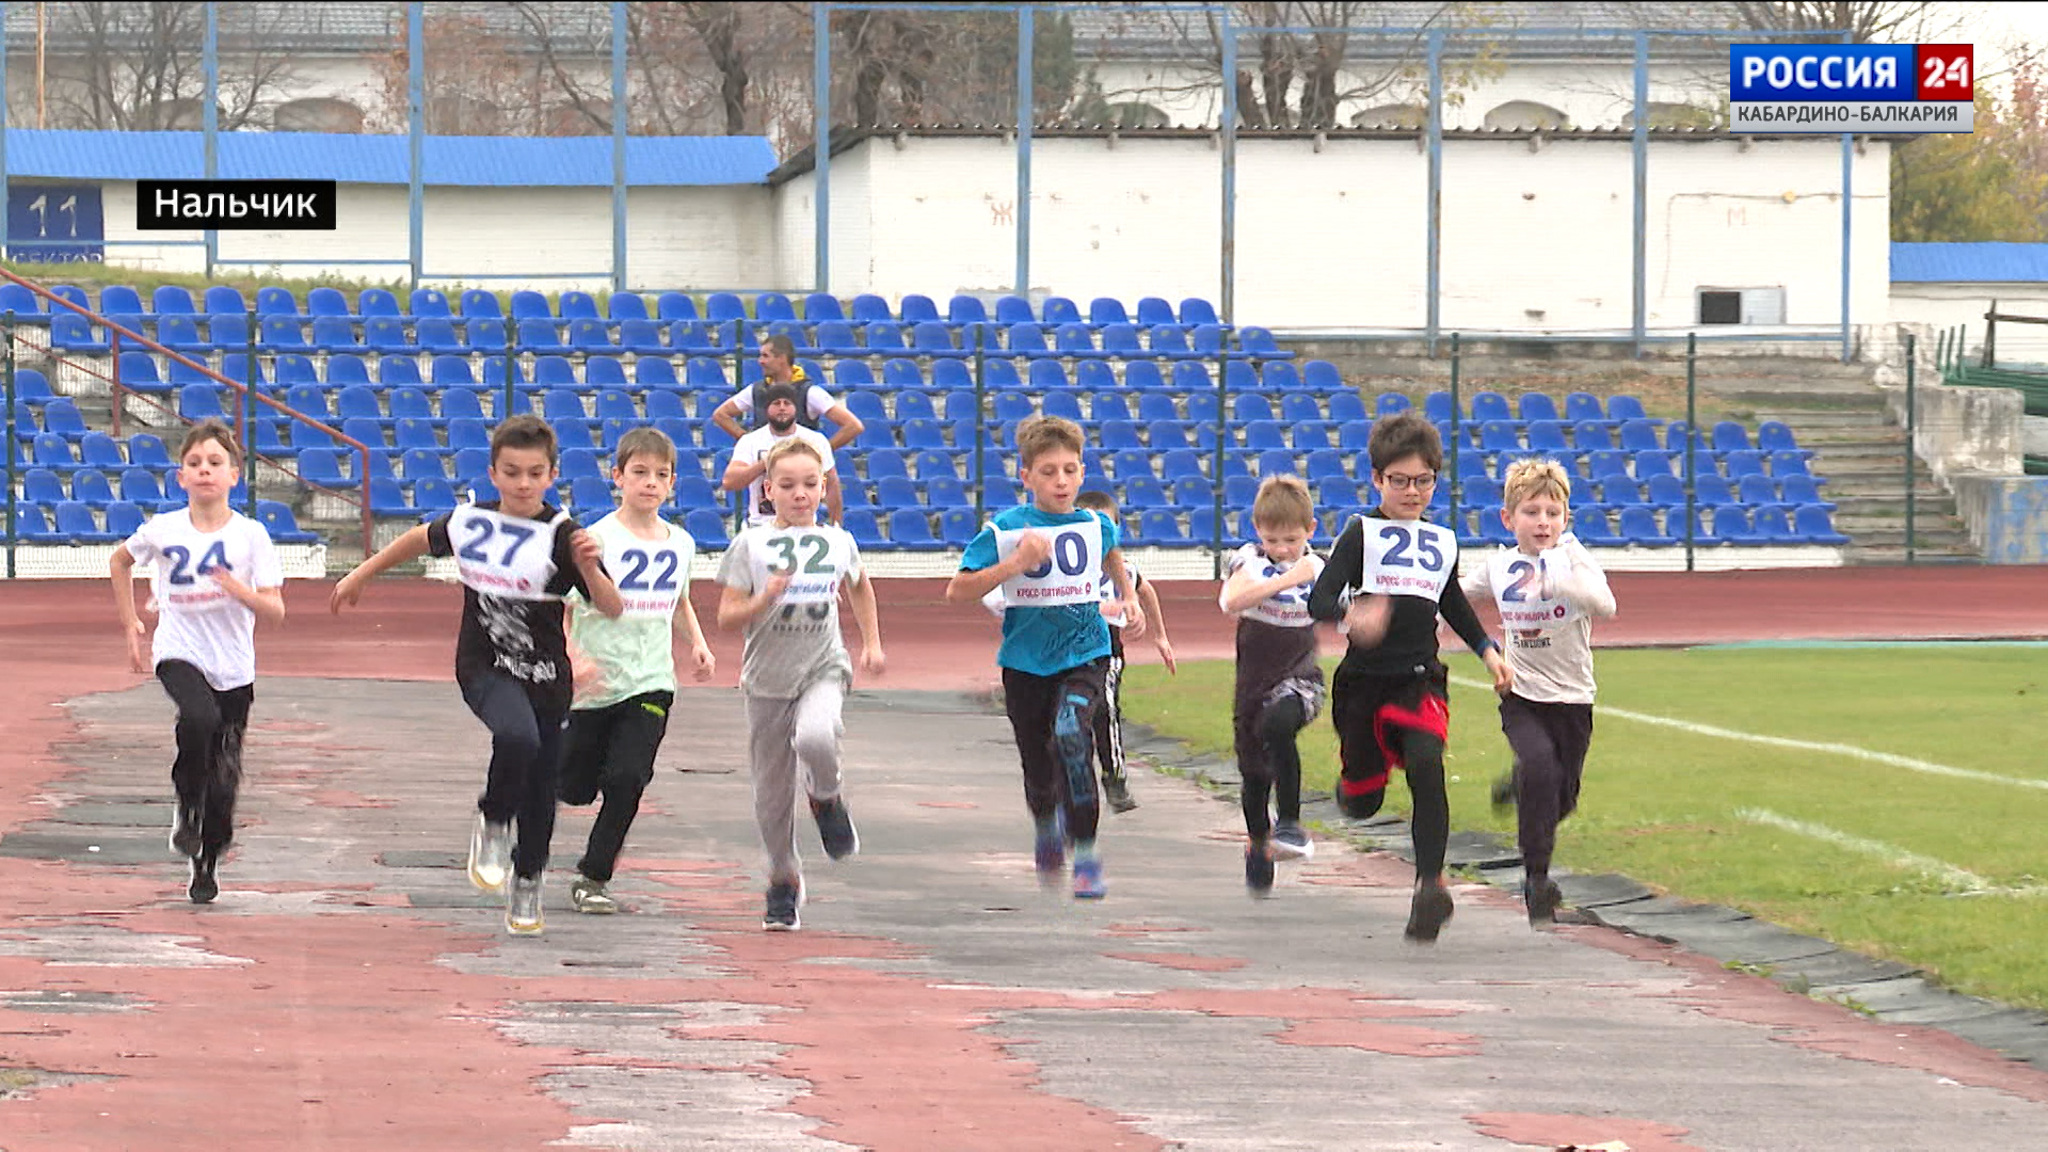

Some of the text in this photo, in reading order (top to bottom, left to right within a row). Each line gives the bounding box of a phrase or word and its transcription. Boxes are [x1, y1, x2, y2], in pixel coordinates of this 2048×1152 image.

[29, 194, 77, 237] 11
[162, 541, 233, 584] 24
[460, 516, 535, 567] 27
[766, 534, 835, 576] 32
[1379, 526, 1443, 572] 25
[618, 548, 678, 590] 22
